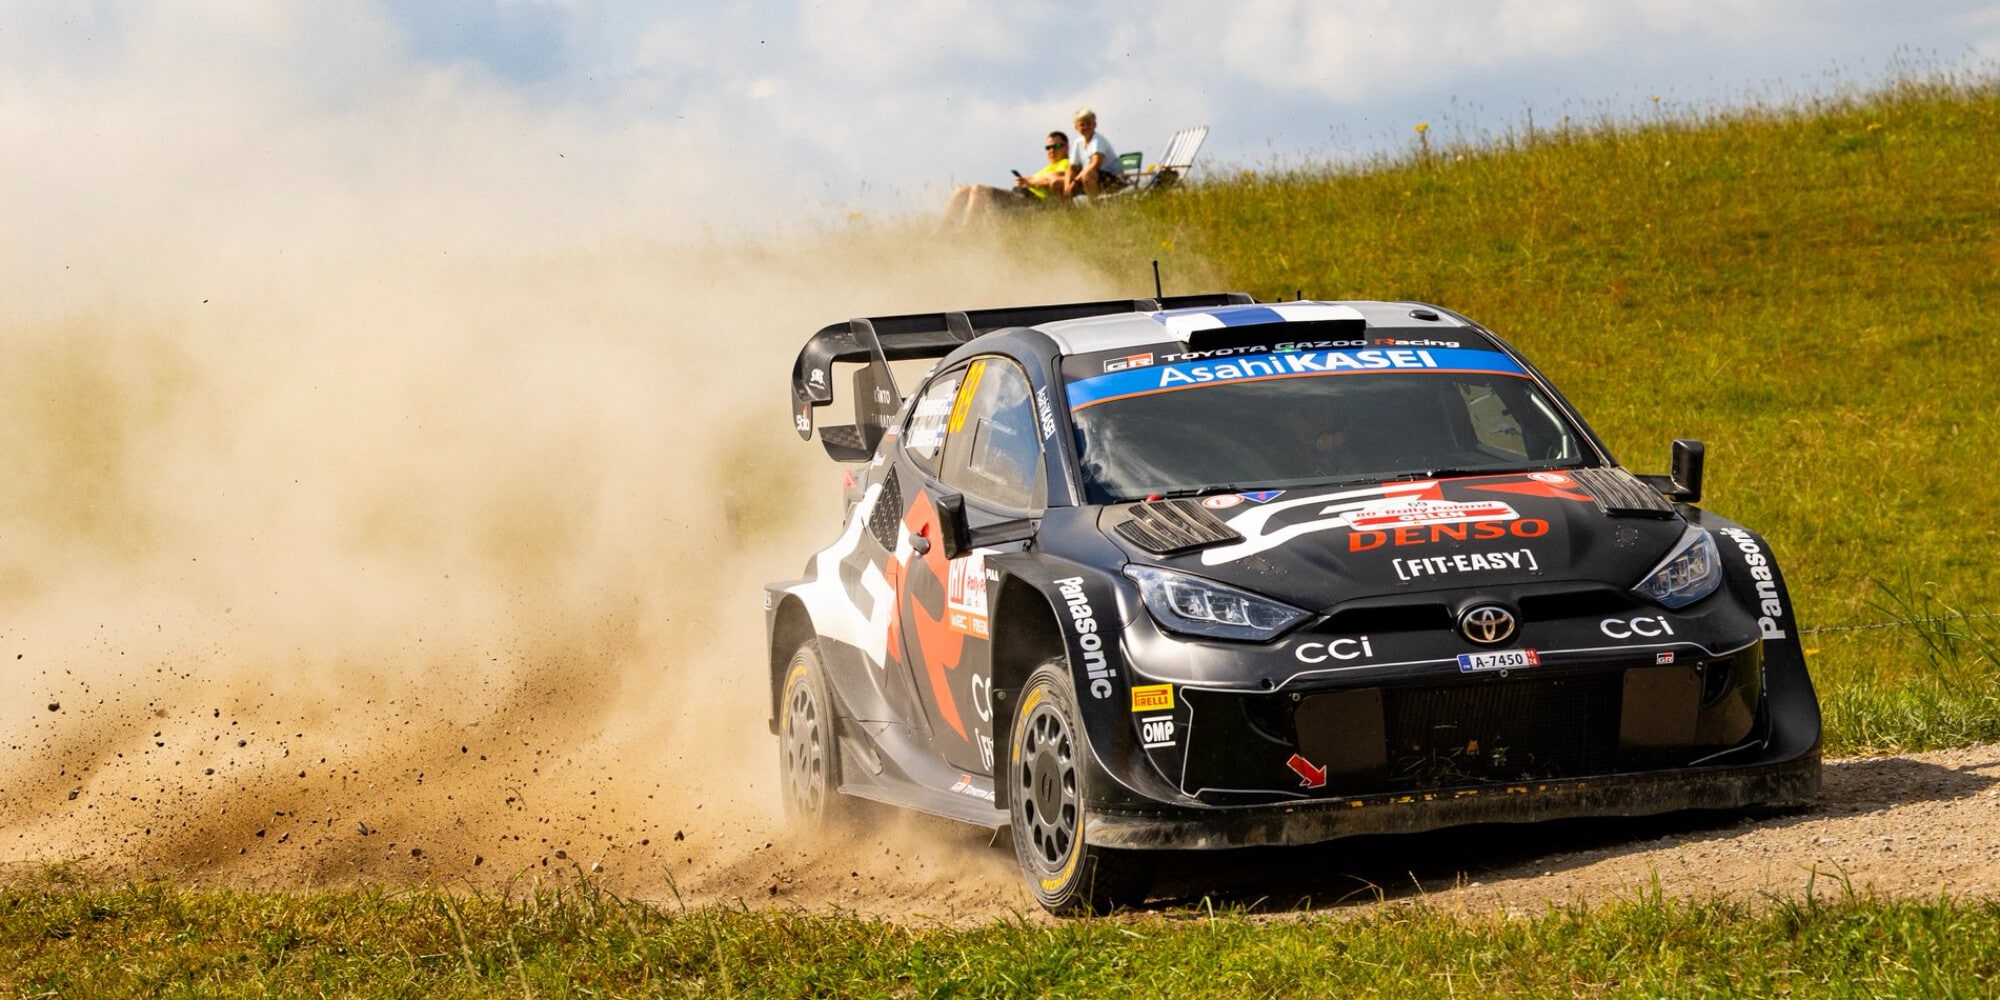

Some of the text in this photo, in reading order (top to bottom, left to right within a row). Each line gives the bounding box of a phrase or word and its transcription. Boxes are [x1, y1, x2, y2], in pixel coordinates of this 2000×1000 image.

[1160, 337, 1460, 363] TOYOTA GAZOO Racing
[1385, 505, 1429, 516] Rally
[1432, 502, 1493, 512] Poland
[1399, 510, 1467, 521] ORLEN
[1348, 518, 1550, 552] DENSO
[1720, 527, 1787, 640] Panasonic
[1053, 576, 1117, 699] Panasonic
[1476, 653, 1524, 668] A-7450
[1134, 690, 1168, 707] PIRELLI
[1143, 720, 1175, 743] OMP
